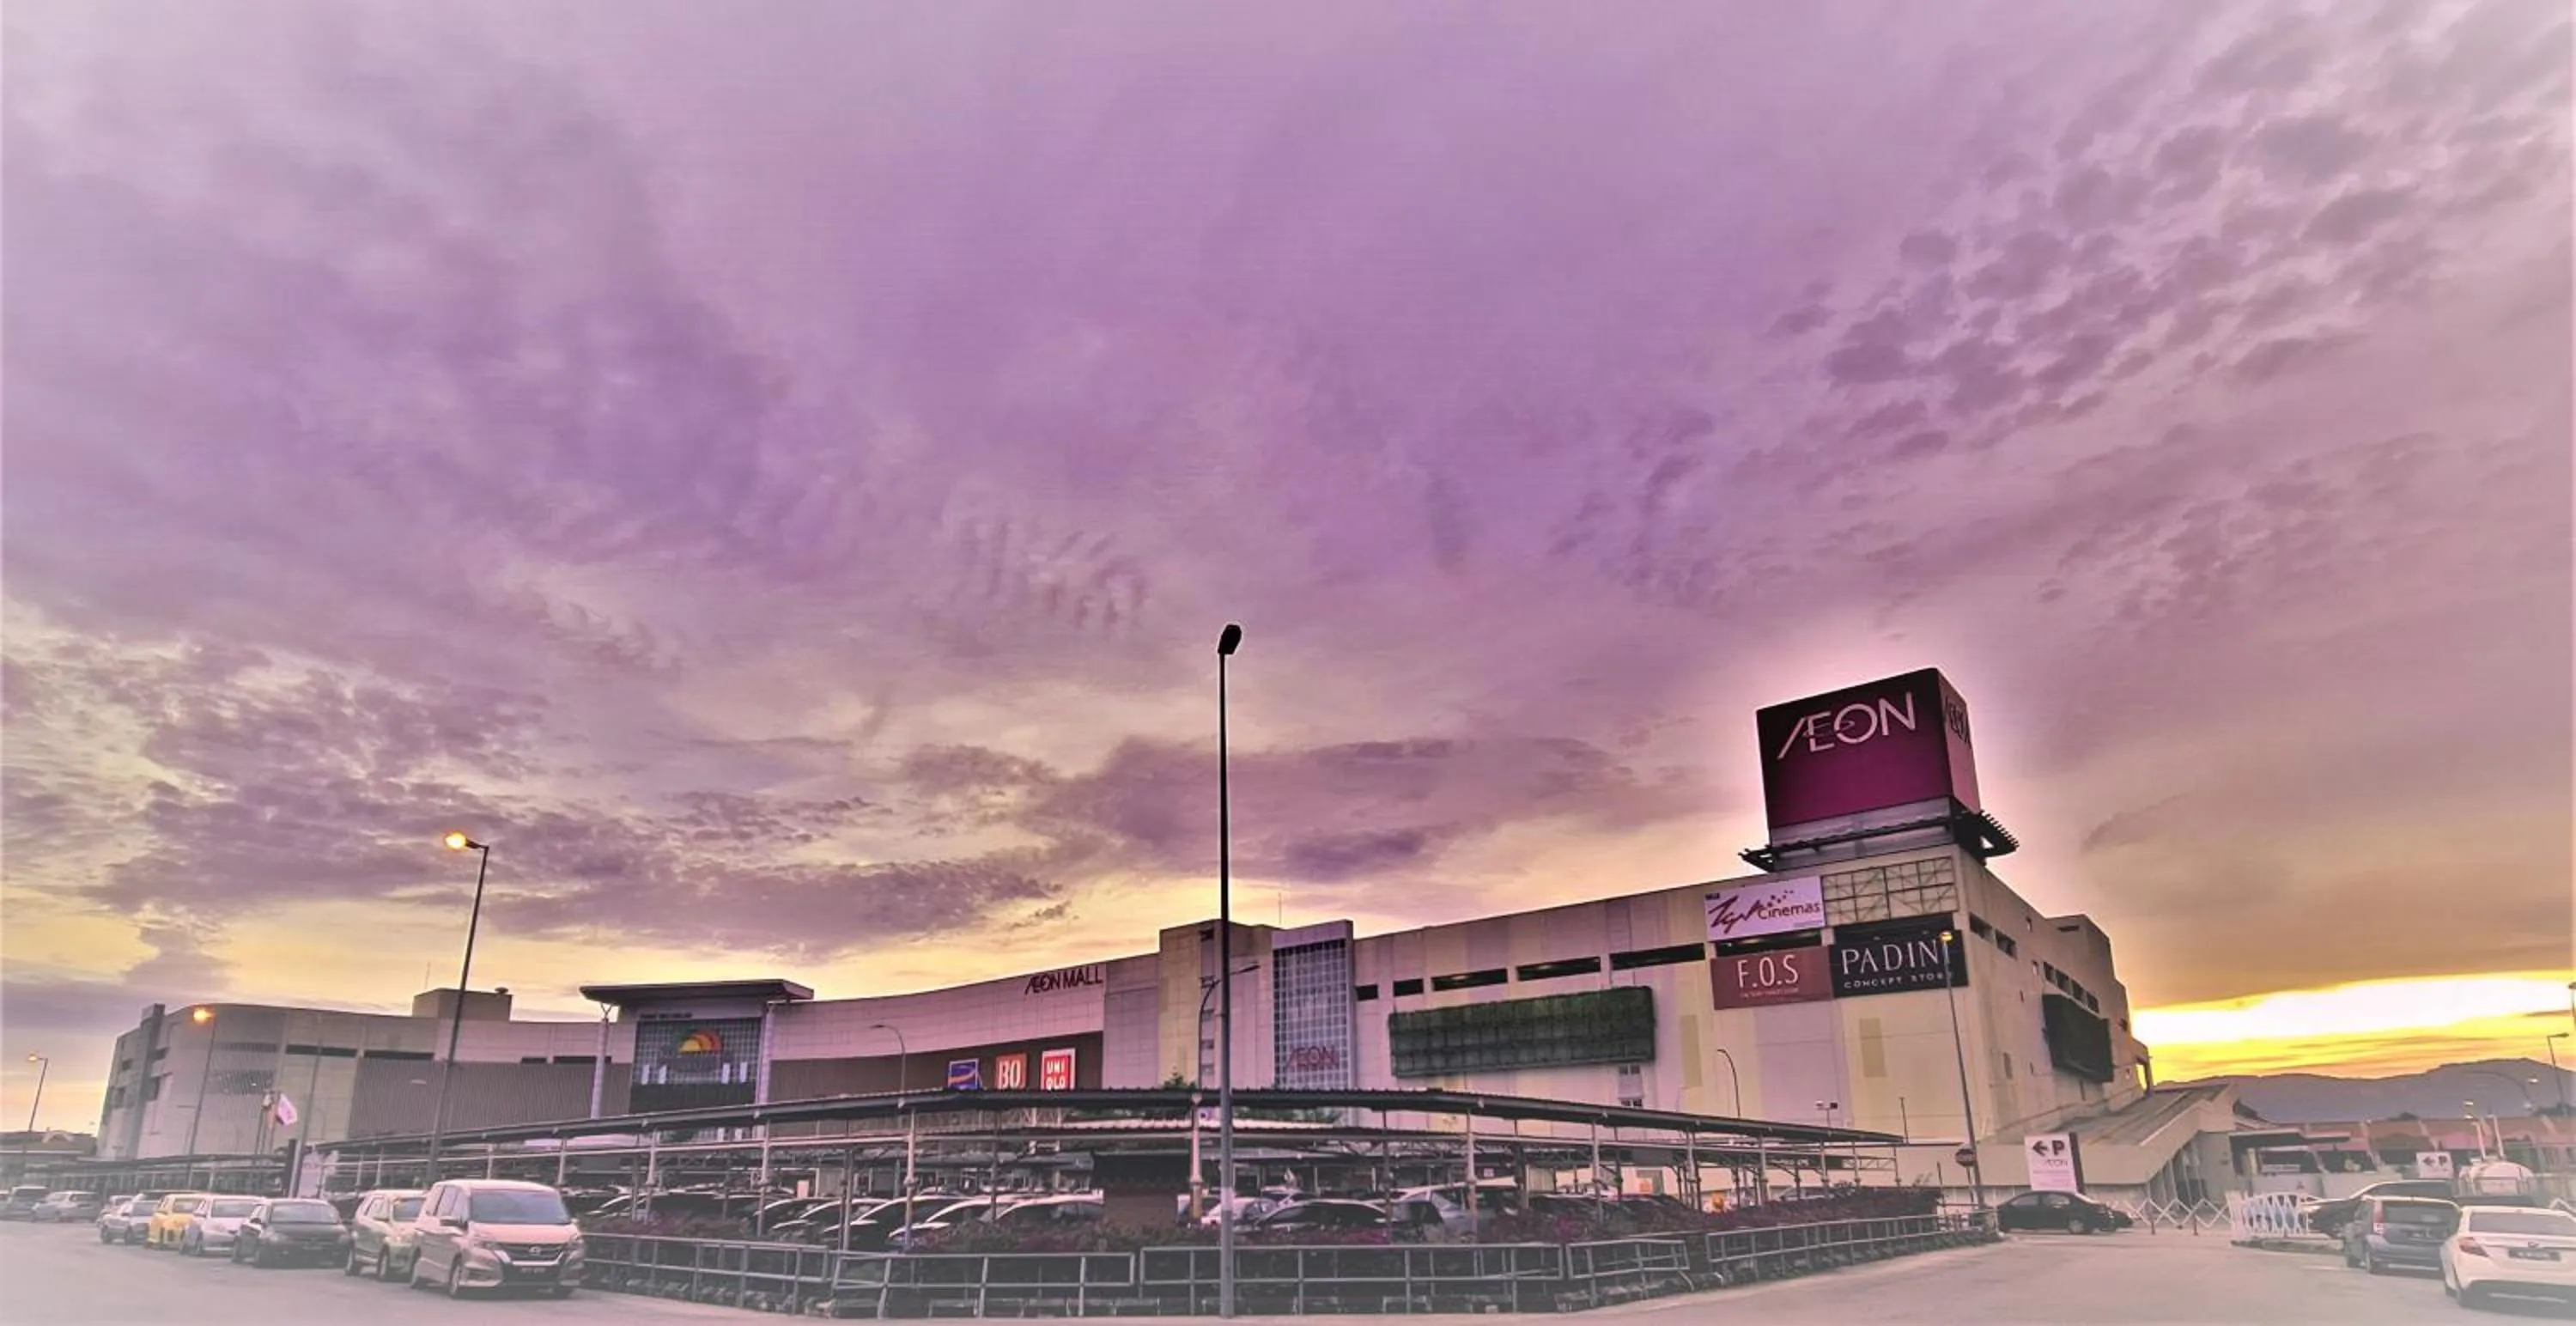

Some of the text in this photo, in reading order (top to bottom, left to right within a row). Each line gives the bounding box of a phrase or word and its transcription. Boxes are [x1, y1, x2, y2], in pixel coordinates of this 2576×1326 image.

[1758, 903, 1820, 920] Cinemas
[1063, 965, 1104, 988] MALL
[1737, 954, 1799, 988] F.O.S
[1844, 976, 1903, 988] CONCEPT
[2051, 1140, 2065, 1156] P
